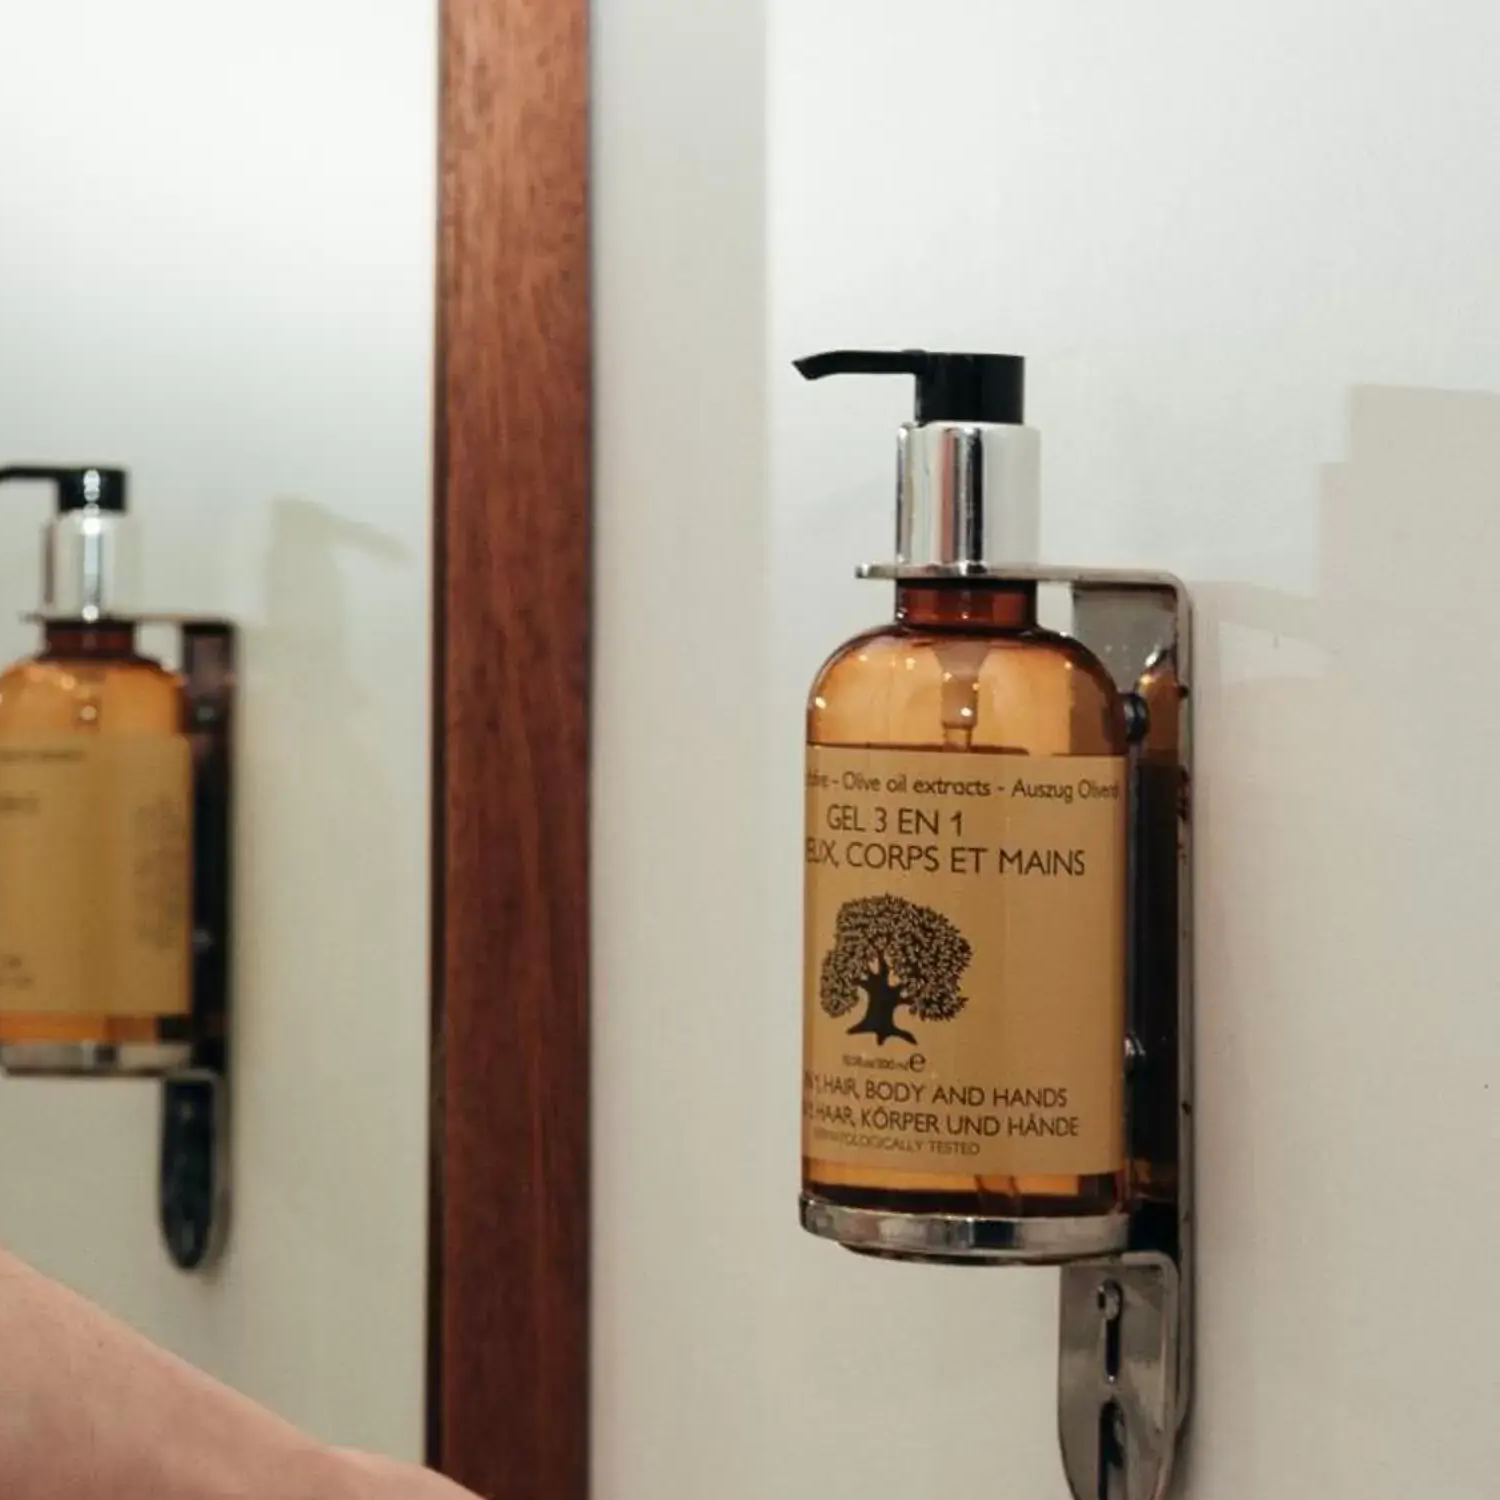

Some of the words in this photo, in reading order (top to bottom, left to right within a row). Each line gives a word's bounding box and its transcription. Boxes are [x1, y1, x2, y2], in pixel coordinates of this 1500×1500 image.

[842, 770, 881, 792] Olive
[886, 774, 907, 793] oil
[912, 776, 991, 797] extracts
[1011, 778, 1073, 804] Auszug
[826, 803, 865, 832] GEL
[875, 806, 887, 832] 3
[898, 807, 939, 838] EN
[950, 810, 962, 837] 1
[846, 841, 940, 873] CORPS
[950, 846, 988, 874] ET
[999, 849, 1086, 877] MAINS
[865, 1078, 926, 1104] BODY
[932, 1084, 986, 1108] AND
[993, 1087, 1068, 1108] HANDS
[946, 1114, 1001, 1138] UND
[928, 1140, 981, 1156] TESTED
